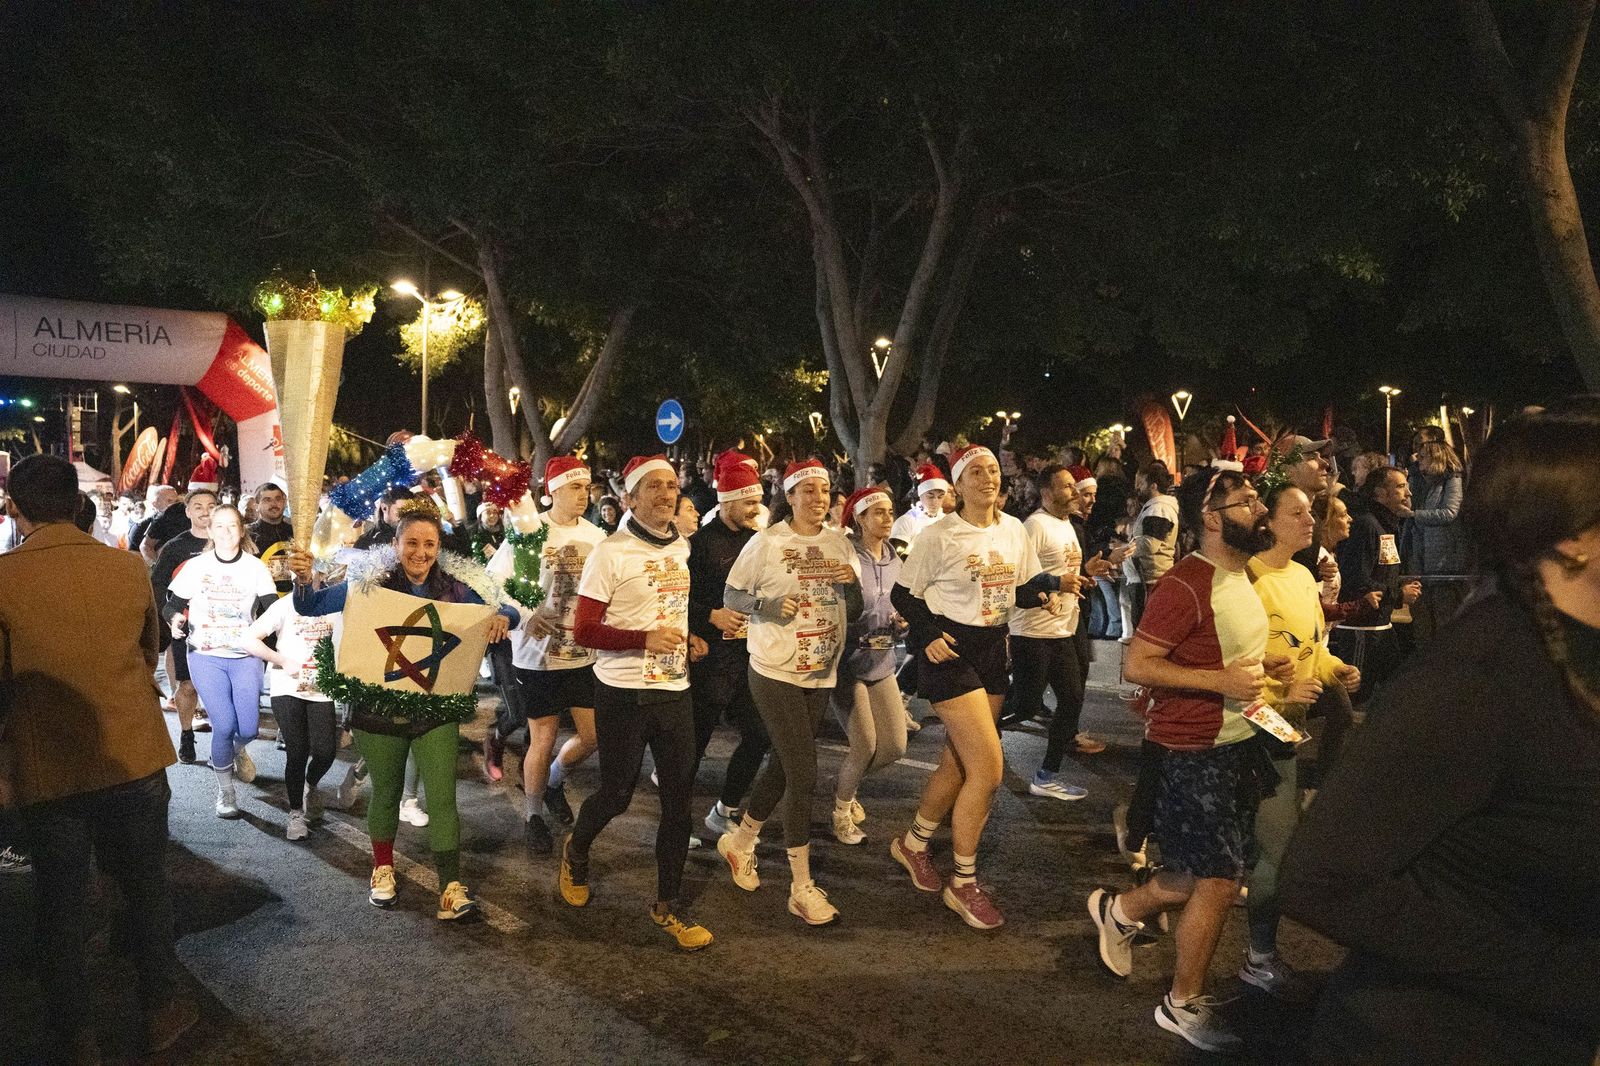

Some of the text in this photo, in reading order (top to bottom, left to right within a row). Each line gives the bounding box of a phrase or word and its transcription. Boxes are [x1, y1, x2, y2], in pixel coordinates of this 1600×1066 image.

[33, 316, 172, 346] ALMERÍA
[32, 342, 106, 360] CIUDAD
[237, 368, 274, 402] deporte
[565, 470, 582, 480] Feliz
[793, 470, 809, 479] Feliz
[740, 486, 756, 496] Feliz
[660, 655, 681, 666] 487
